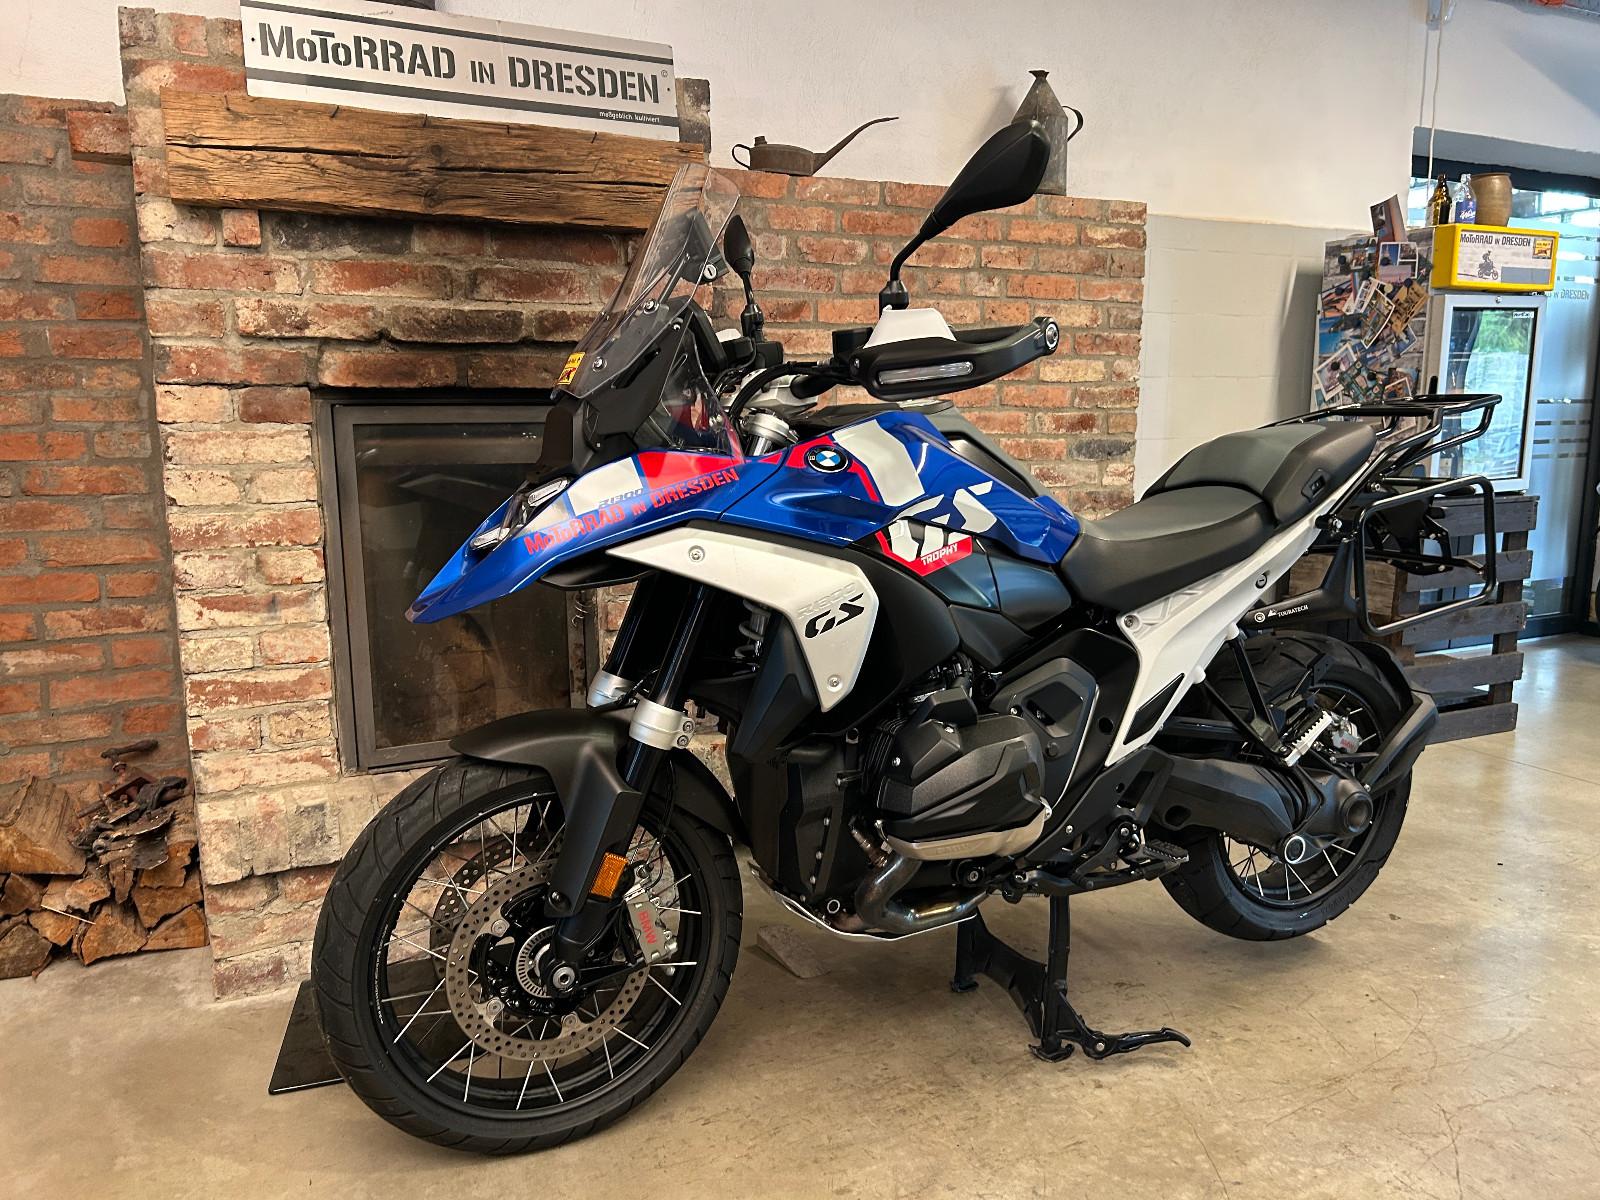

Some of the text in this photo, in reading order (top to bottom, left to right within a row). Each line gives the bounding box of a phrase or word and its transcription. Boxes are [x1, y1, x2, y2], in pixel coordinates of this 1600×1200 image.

[470, 60, 496, 84] IN
[508, 56, 660, 104] DRESDEN
[1501, 236, 1531, 247] DRESDEN
[630, 501, 647, 516] IN
[650, 468, 739, 509] DRESDEN
[920, 543, 958, 565] TROPHY
[804, 591, 865, 639] GS
[1277, 604, 1309, 617] TOURATECH
[639, 911, 657, 944] BMW
